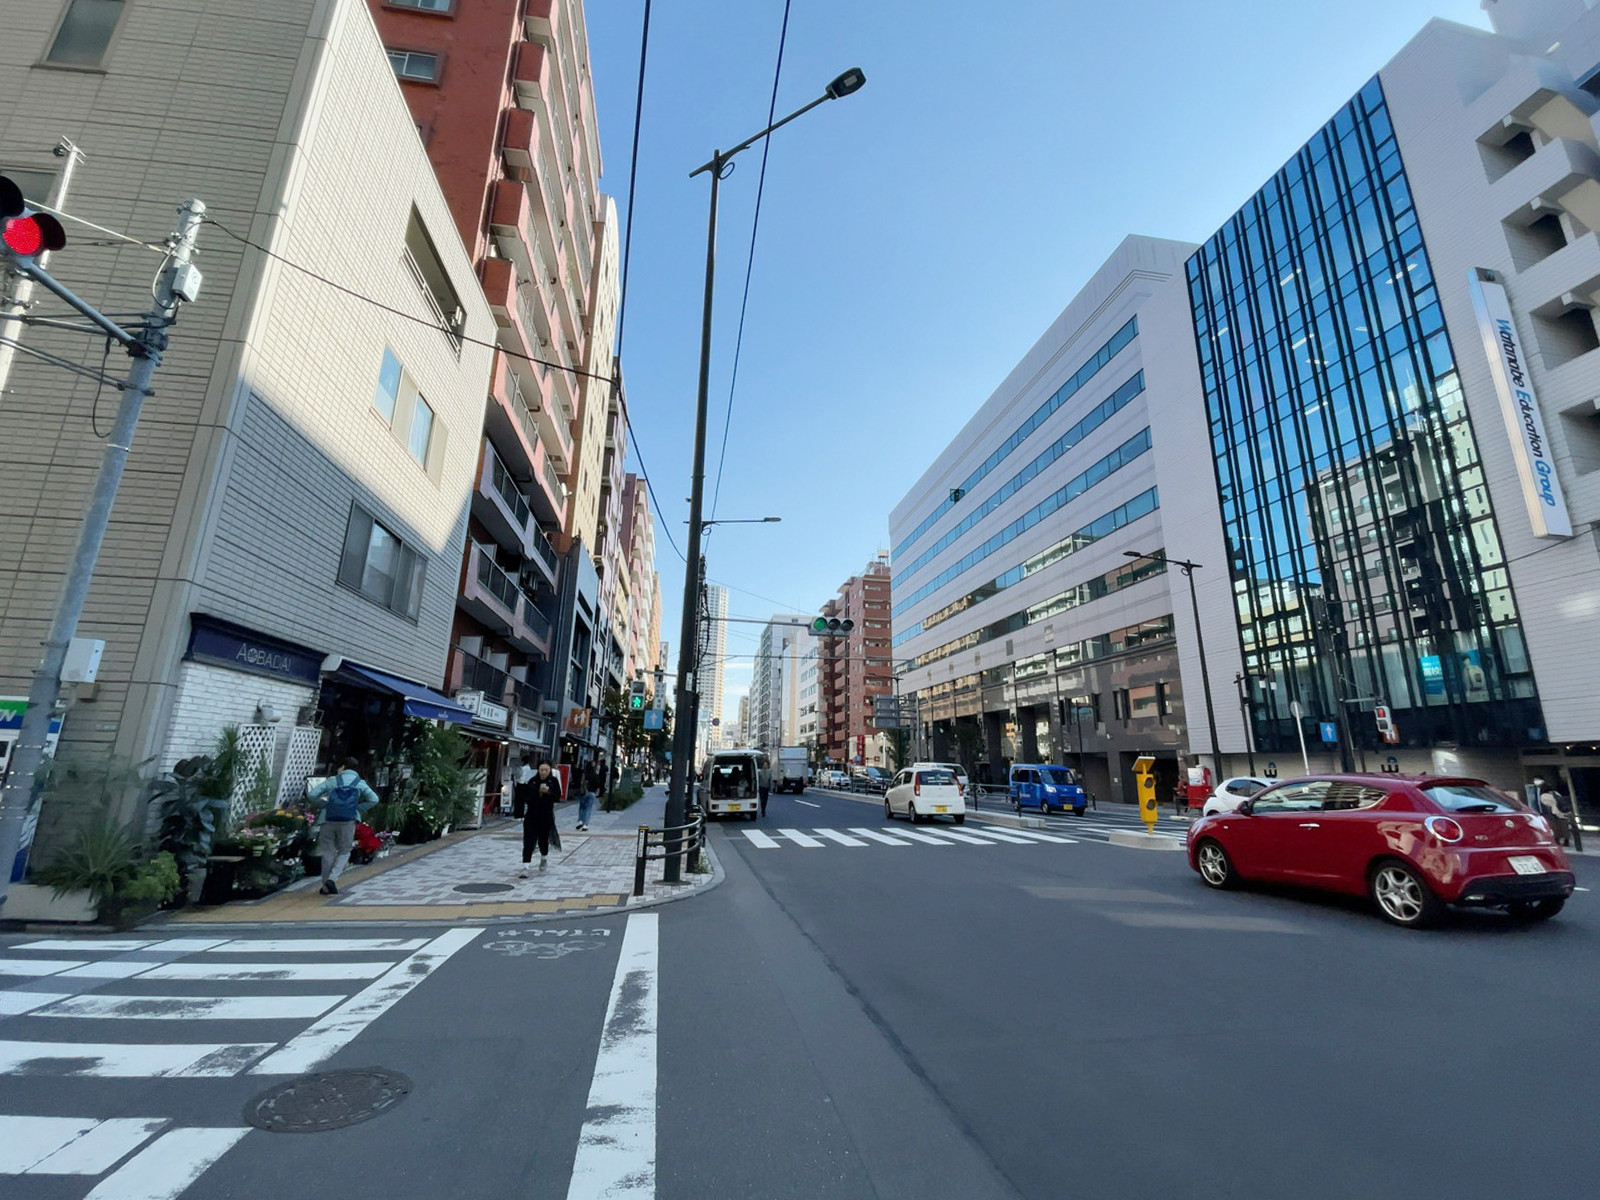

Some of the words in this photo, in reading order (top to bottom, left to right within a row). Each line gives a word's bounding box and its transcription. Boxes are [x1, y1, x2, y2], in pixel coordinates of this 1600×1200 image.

[1496, 319, 1525, 387] Watanabe
[1515, 389, 1543, 458] Education
[1535, 460, 1555, 507] Group
